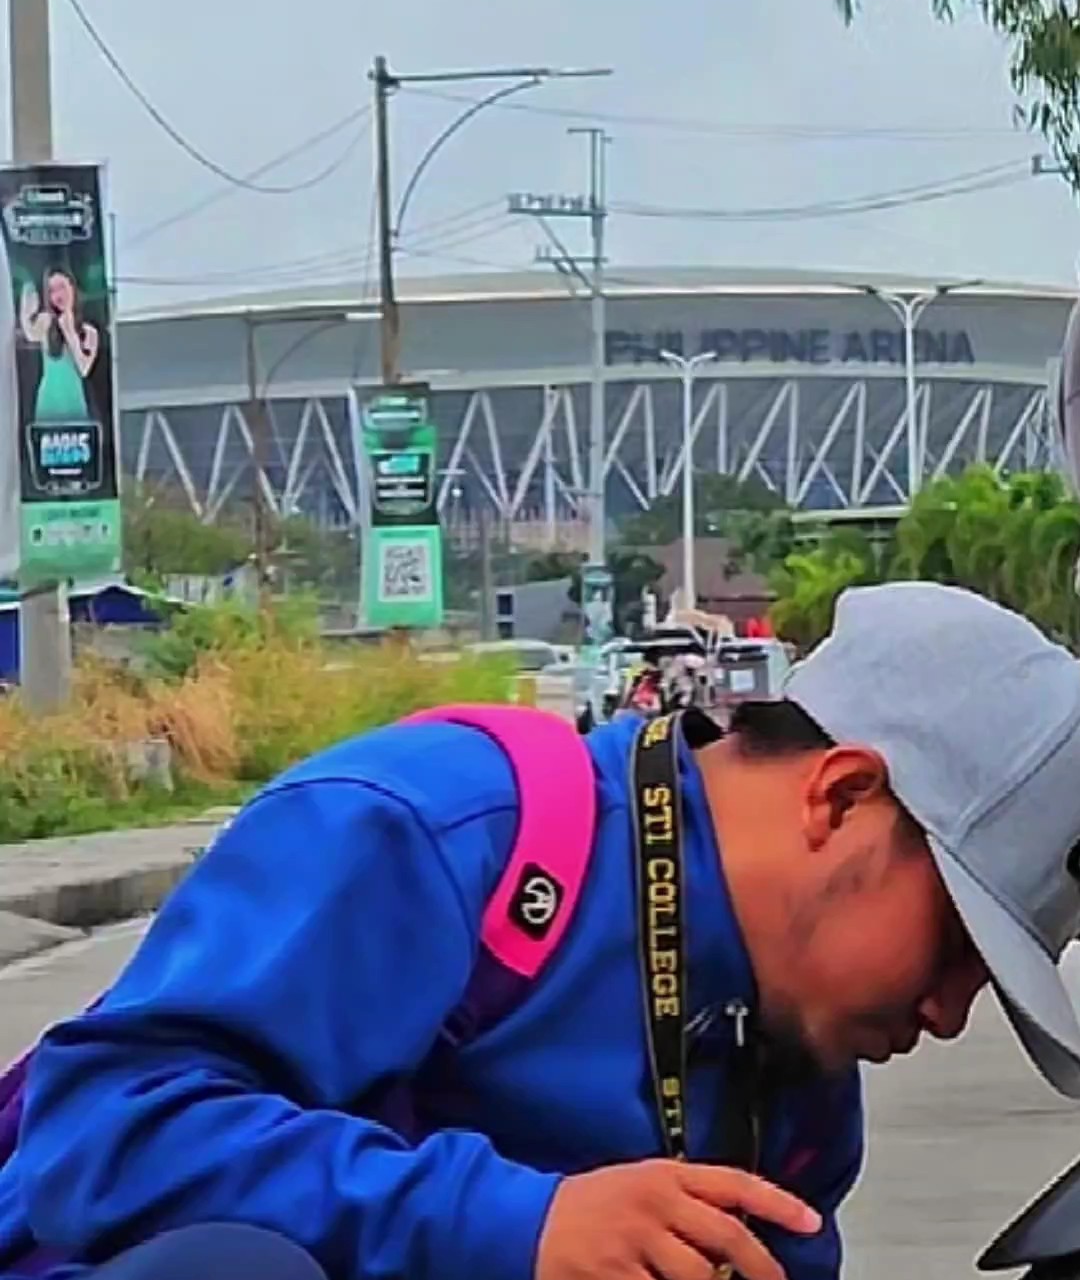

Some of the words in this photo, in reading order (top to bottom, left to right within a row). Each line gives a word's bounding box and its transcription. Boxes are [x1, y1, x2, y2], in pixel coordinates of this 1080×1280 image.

[604, 328, 831, 367] PHILIPPINE
[840, 328, 975, 365] ARENA
[643, 785, 673, 845] STI
[647, 858, 680, 1018] COLLEGE
